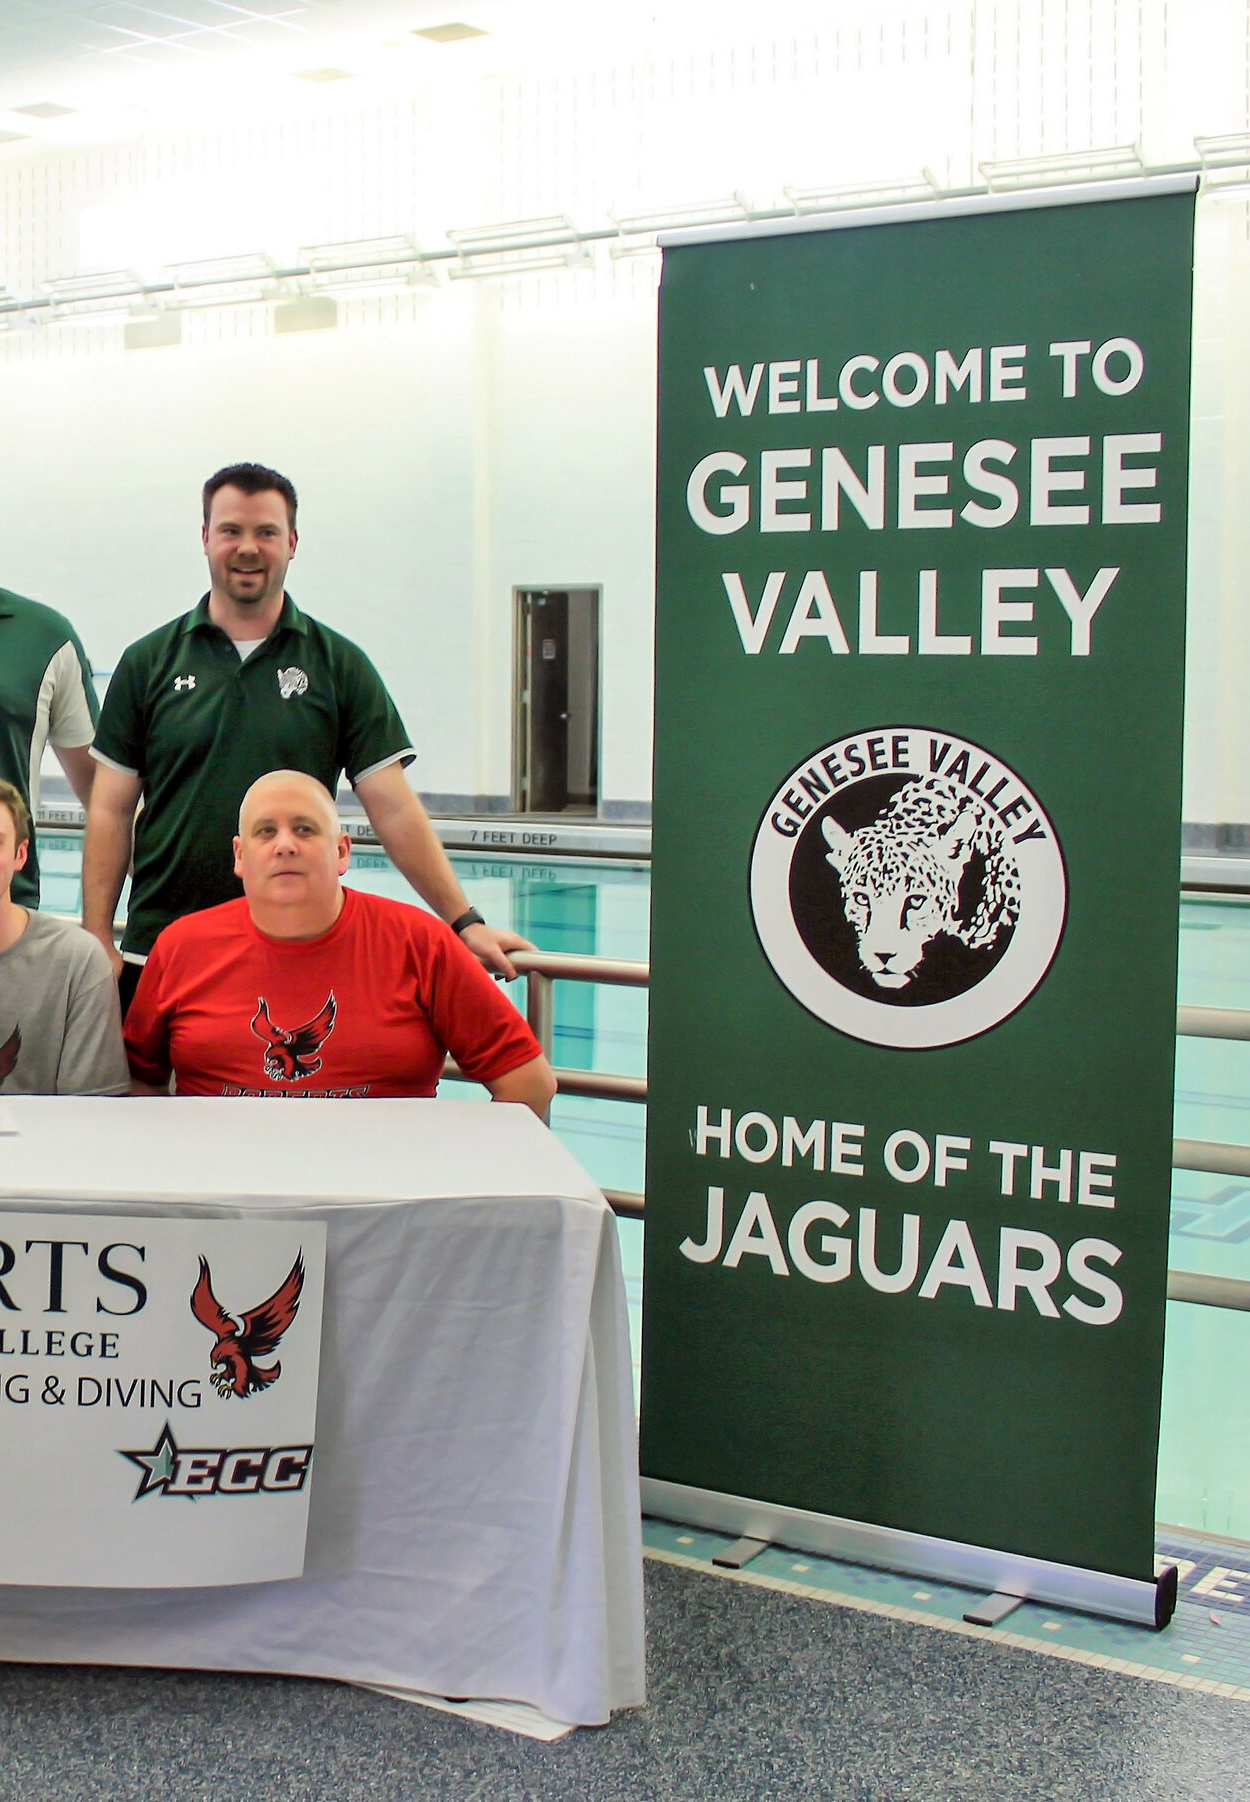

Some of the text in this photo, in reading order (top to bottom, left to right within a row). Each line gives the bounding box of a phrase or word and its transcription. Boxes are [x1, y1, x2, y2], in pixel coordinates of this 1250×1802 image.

[703, 337, 1144, 418] WELCOME TO
[686, 432, 1162, 536] GENESEE
[721, 566, 1121, 656] VALLEY
[48, 810, 74, 821] FEET
[770, 735, 1047, 845] GENESEE VALLEY
[470, 830, 558, 846] 7 FEET DEEP
[695, 1105, 1117, 1209] HOME OF THE
[678, 1185, 1125, 1326] JAGUARS
[40, 1374, 66, 1406] &
[78, 1376, 202, 1409] DIVING
[162, 1445, 313, 1495] ECC
